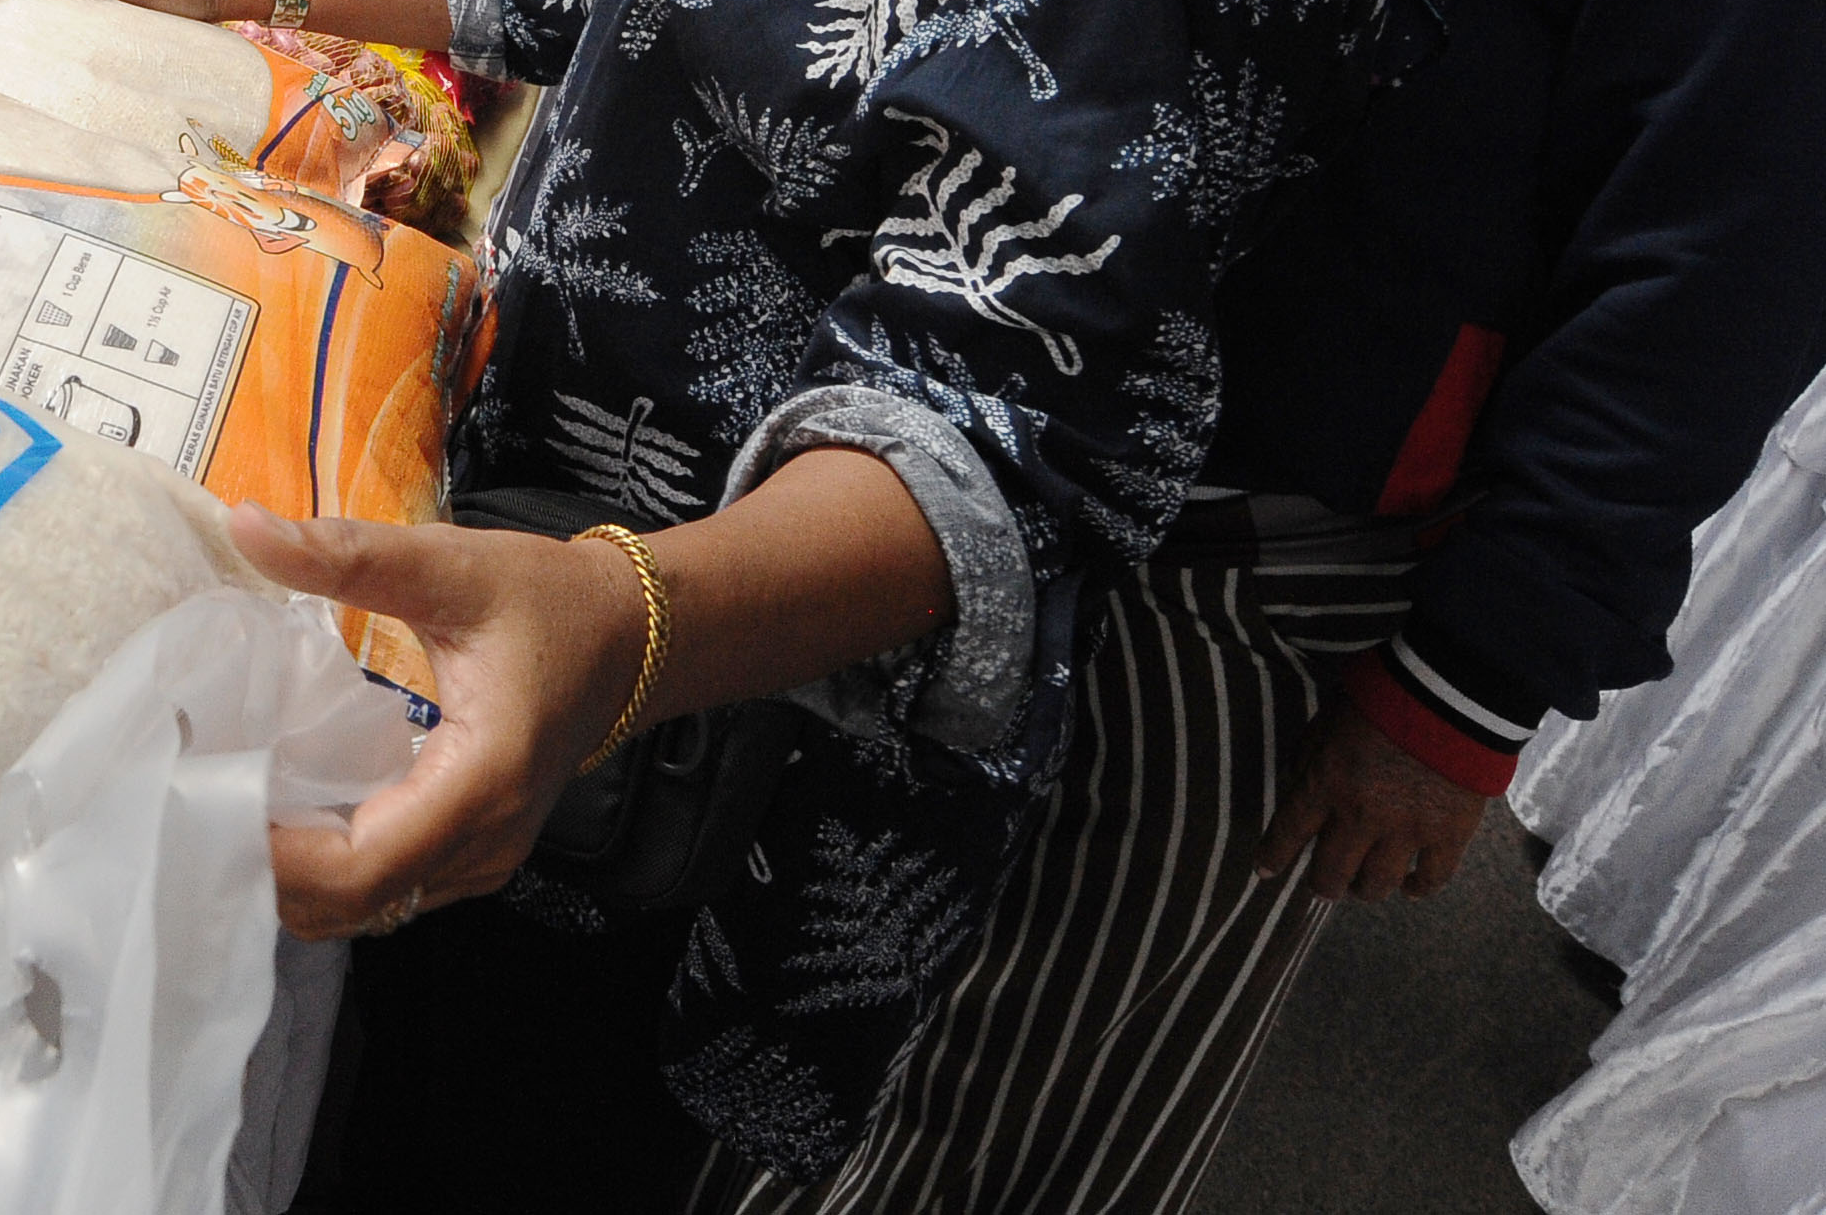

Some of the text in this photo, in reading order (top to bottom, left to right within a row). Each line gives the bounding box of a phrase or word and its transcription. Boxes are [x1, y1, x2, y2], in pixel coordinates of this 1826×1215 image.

[73, 249, 92, 275] Beras
[3, 346, 32, 392] UNAKAN
[18, 361, 44, 400] OKER
[190, 388, 220, 432] GUNAKAN
[180, 429, 204, 463] BERAS
